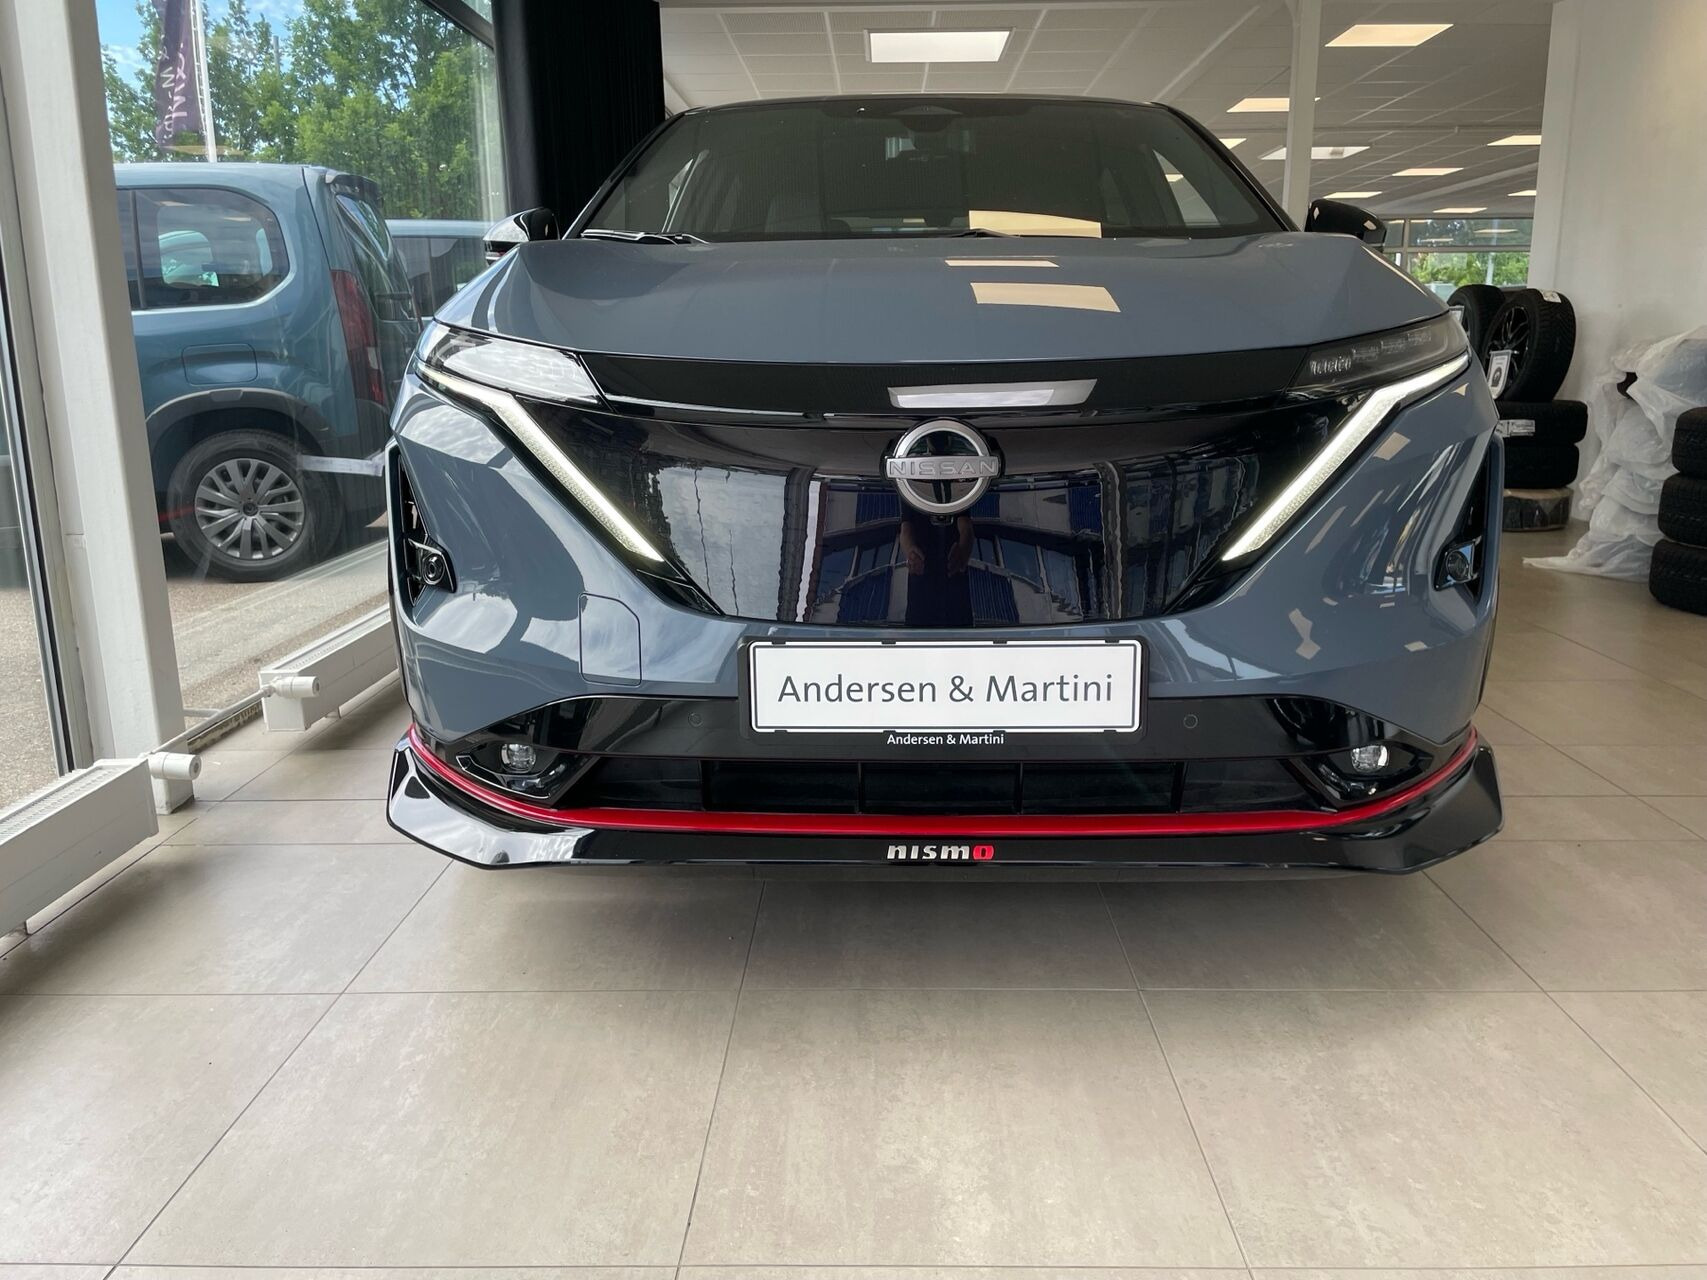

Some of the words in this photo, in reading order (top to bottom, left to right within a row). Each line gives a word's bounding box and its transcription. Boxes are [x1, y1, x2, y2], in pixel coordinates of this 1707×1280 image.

[889, 459, 997, 476] NISSAN
[777, 673, 936, 703] Andersen
[949, 675, 974, 703] &
[986, 673, 1112, 702] Martini
[886, 733, 944, 745] Andersen
[946, 734, 957, 745] &
[959, 733, 1005, 745] Martini
[886, 844, 995, 861] nismo
